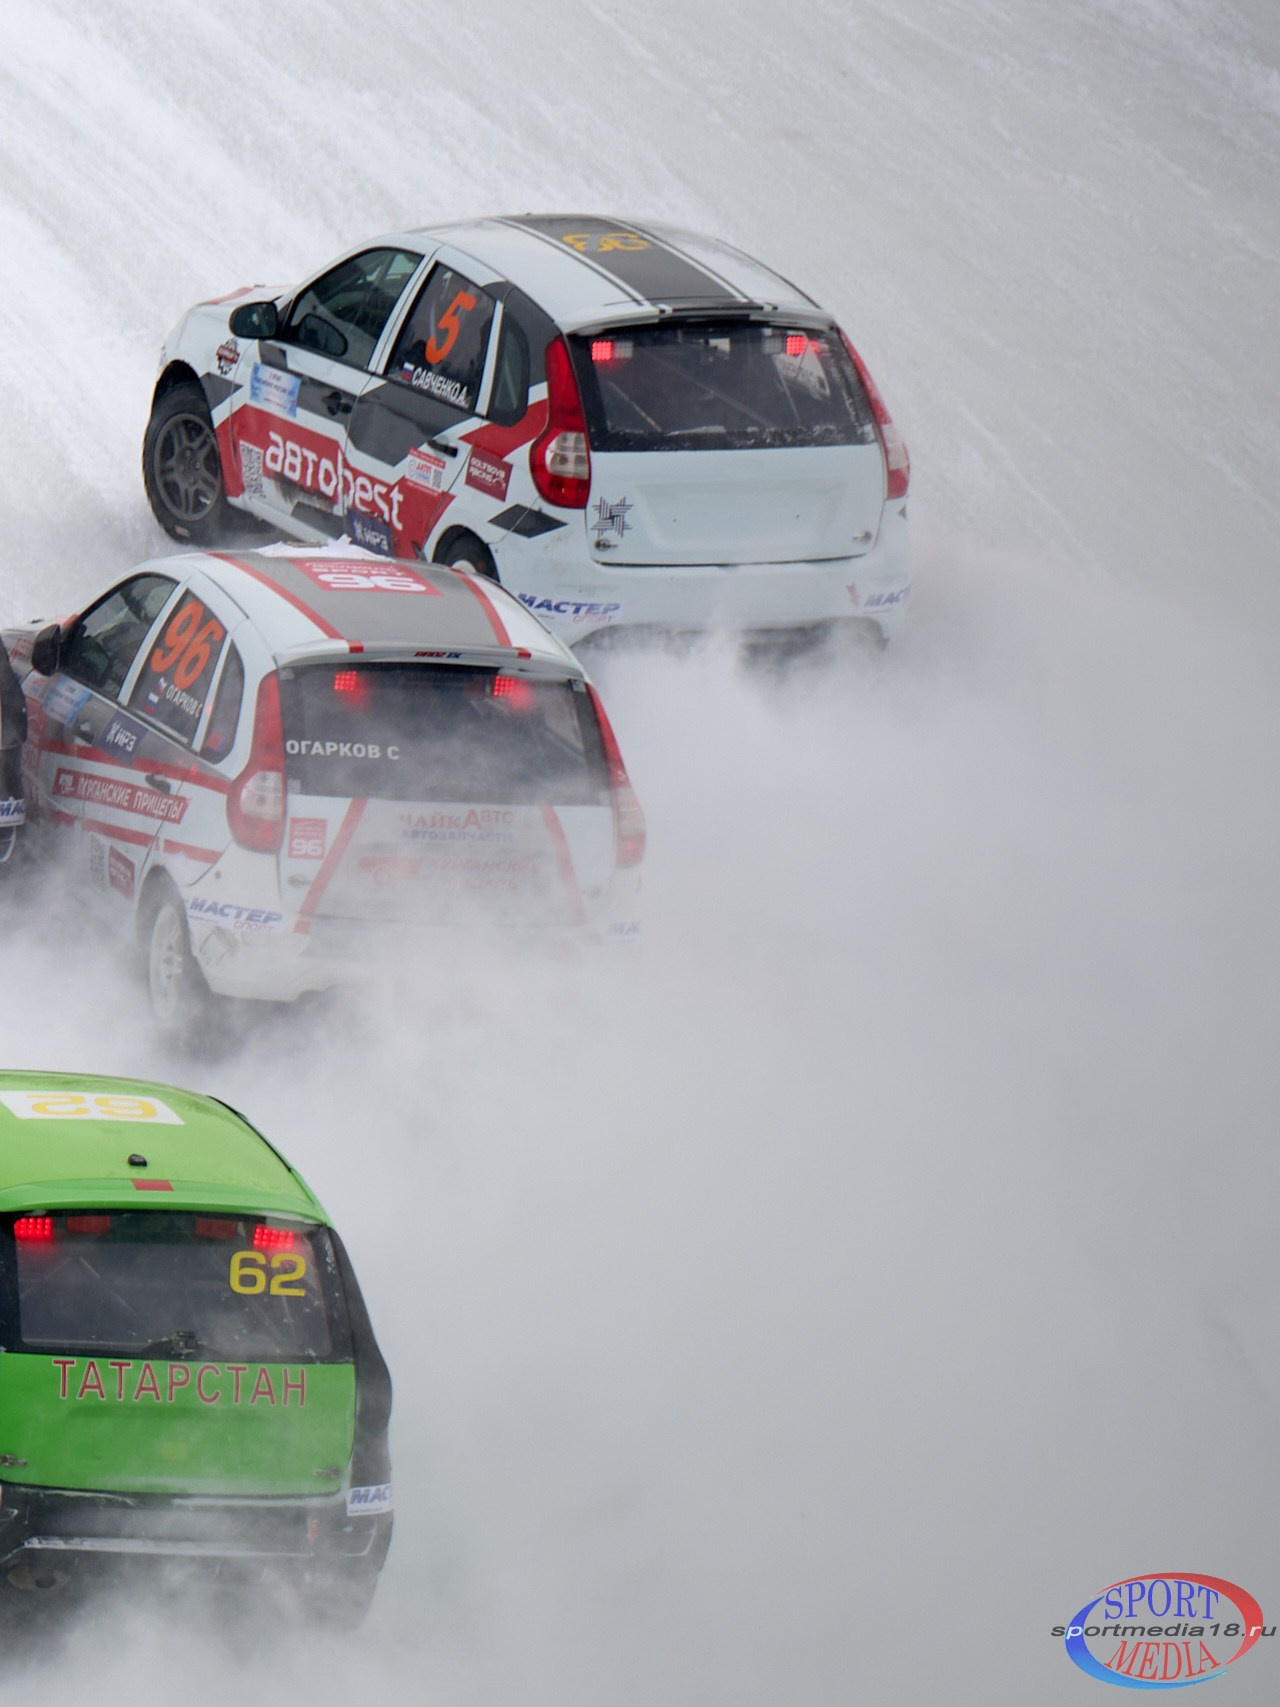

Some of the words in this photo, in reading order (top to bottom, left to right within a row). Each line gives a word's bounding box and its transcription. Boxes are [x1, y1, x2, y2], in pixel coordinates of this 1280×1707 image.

[425, 290, 477, 364] 5
[318, 574, 426, 592] 96
[518, 592, 621, 615] МАСТЕР
[150, 600, 225, 690] 96
[285, 740, 381, 758] ОГАРКОВ
[387, 746, 400, 759] С
[132, 791, 183, 820] ПРИЦЕПЫ
[290, 838, 323, 856] 96
[189, 898, 284, 924] МАСТЕР
[229, 1251, 307, 1297] 62
[52, 1359, 307, 1407] ТАТАРСТАН
